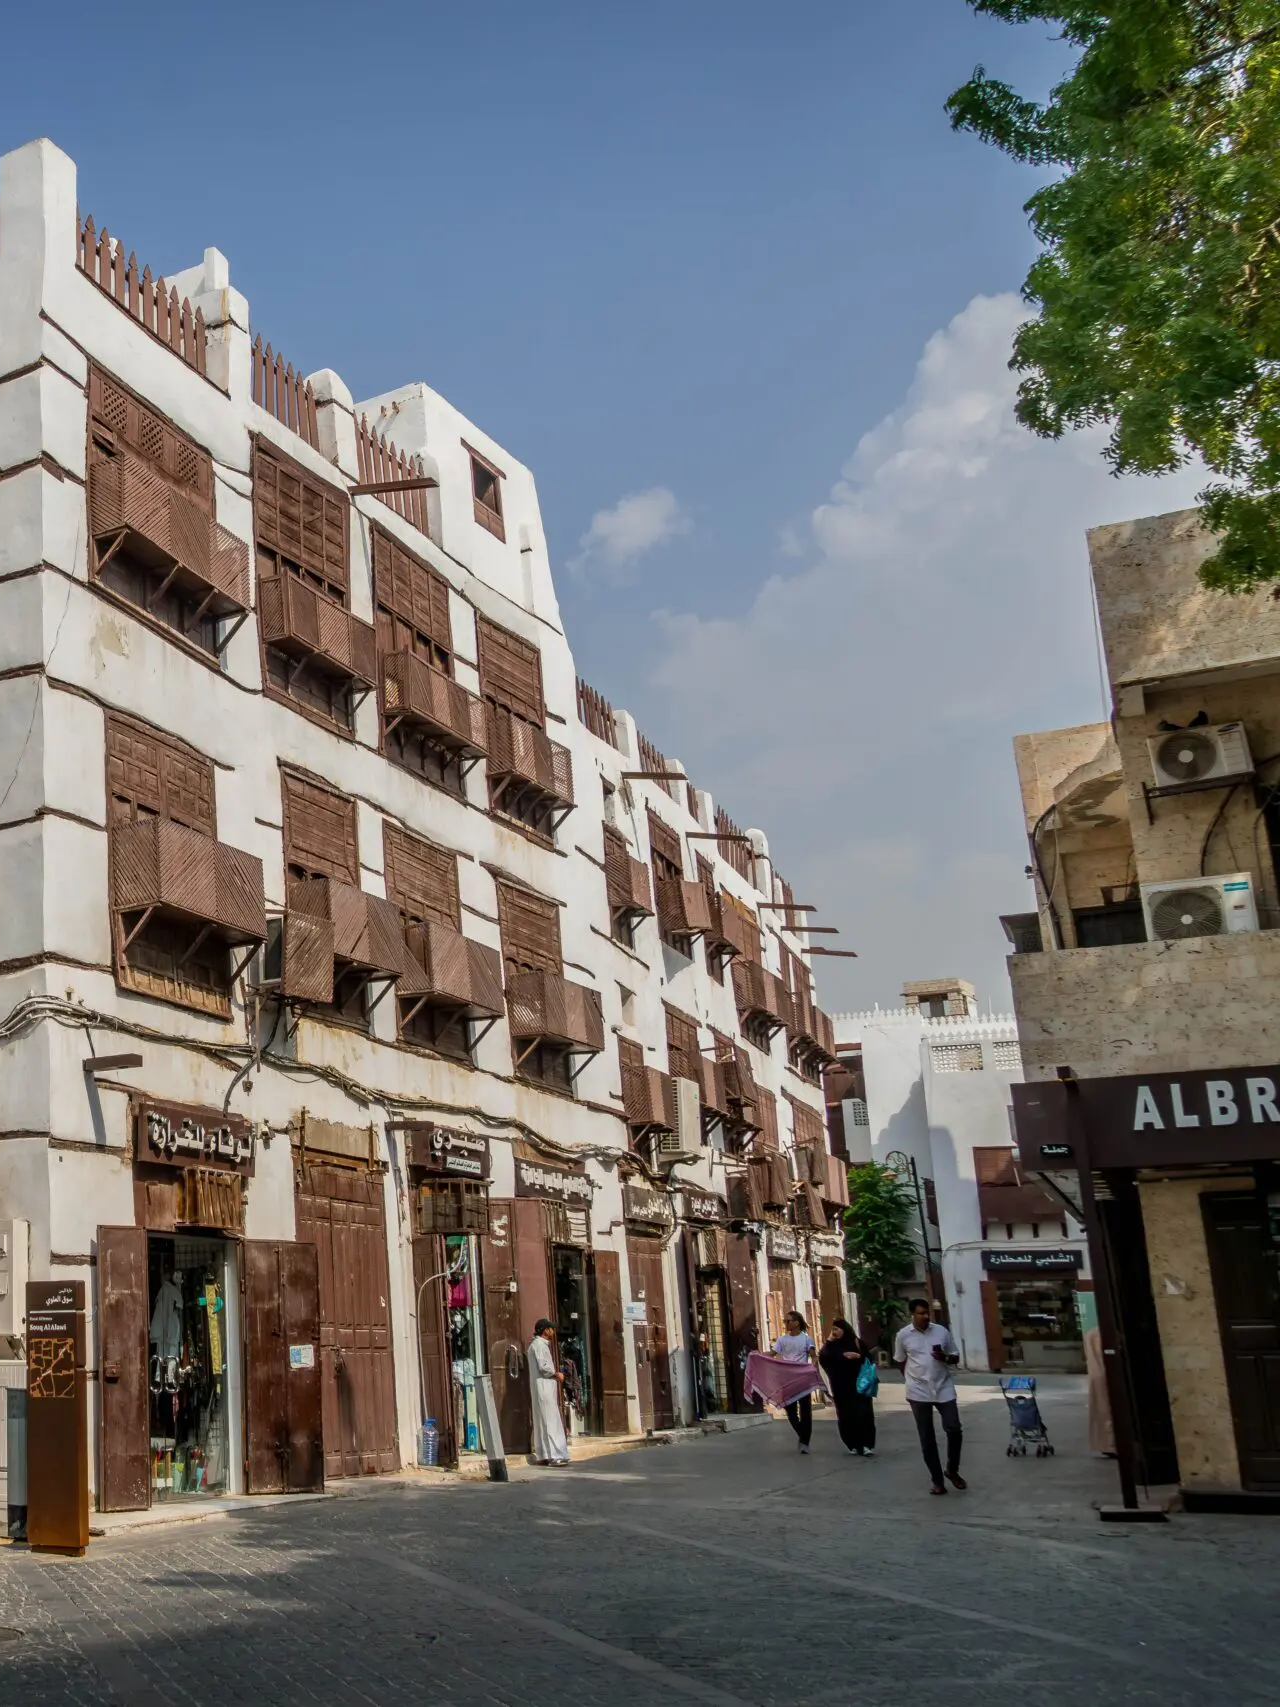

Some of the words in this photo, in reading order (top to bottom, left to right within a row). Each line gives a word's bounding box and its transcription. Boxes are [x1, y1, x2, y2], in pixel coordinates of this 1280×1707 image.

[1133, 1077, 1280, 1131] ALBR
[45, 1295, 61, 1306] العلوي
[61, 1296, 73, 1304] سوق
[30, 1324, 43, 1332] Souq
